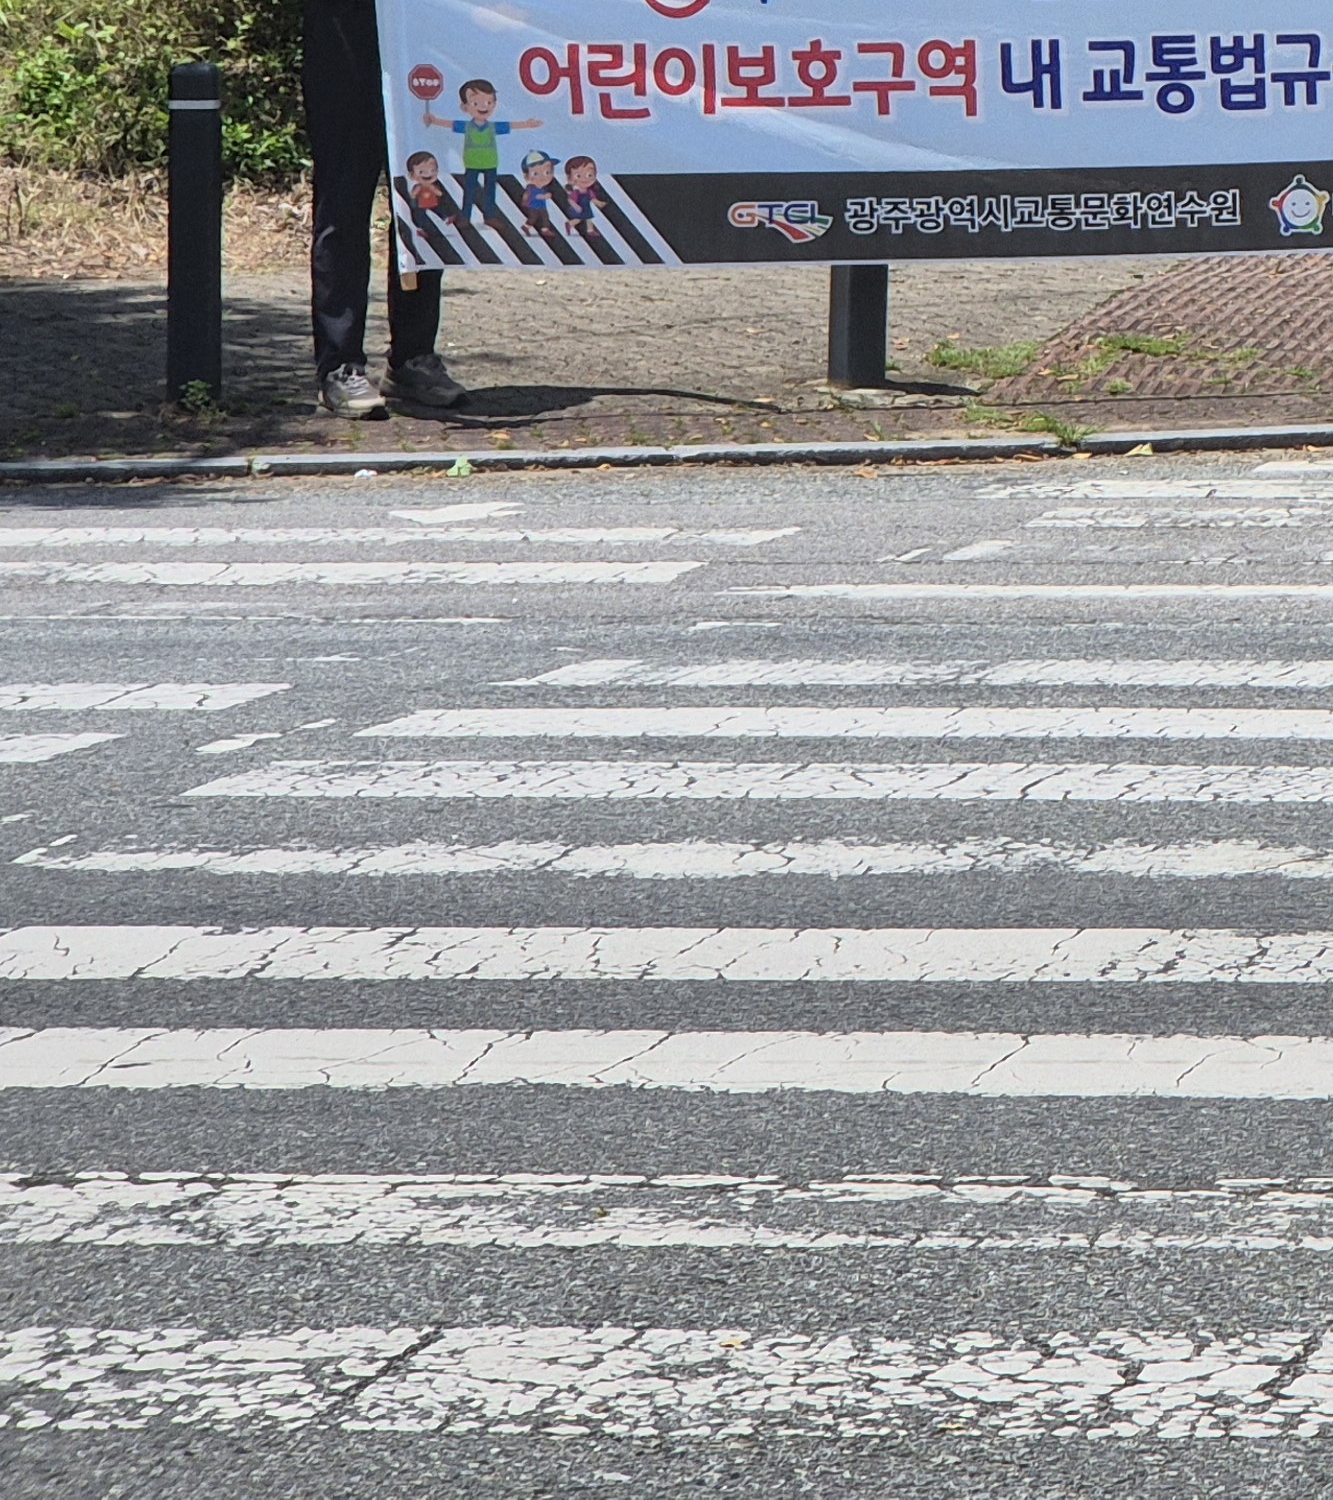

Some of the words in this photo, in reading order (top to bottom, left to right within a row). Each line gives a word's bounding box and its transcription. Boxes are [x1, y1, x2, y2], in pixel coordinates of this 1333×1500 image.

[412, 77, 440, 87] STOP
[518, 37, 978, 119] 어린이보호구역
[1000, 39, 1062, 110] 내
[844, 188, 1241, 233] 광주광역시교통문화연수원
